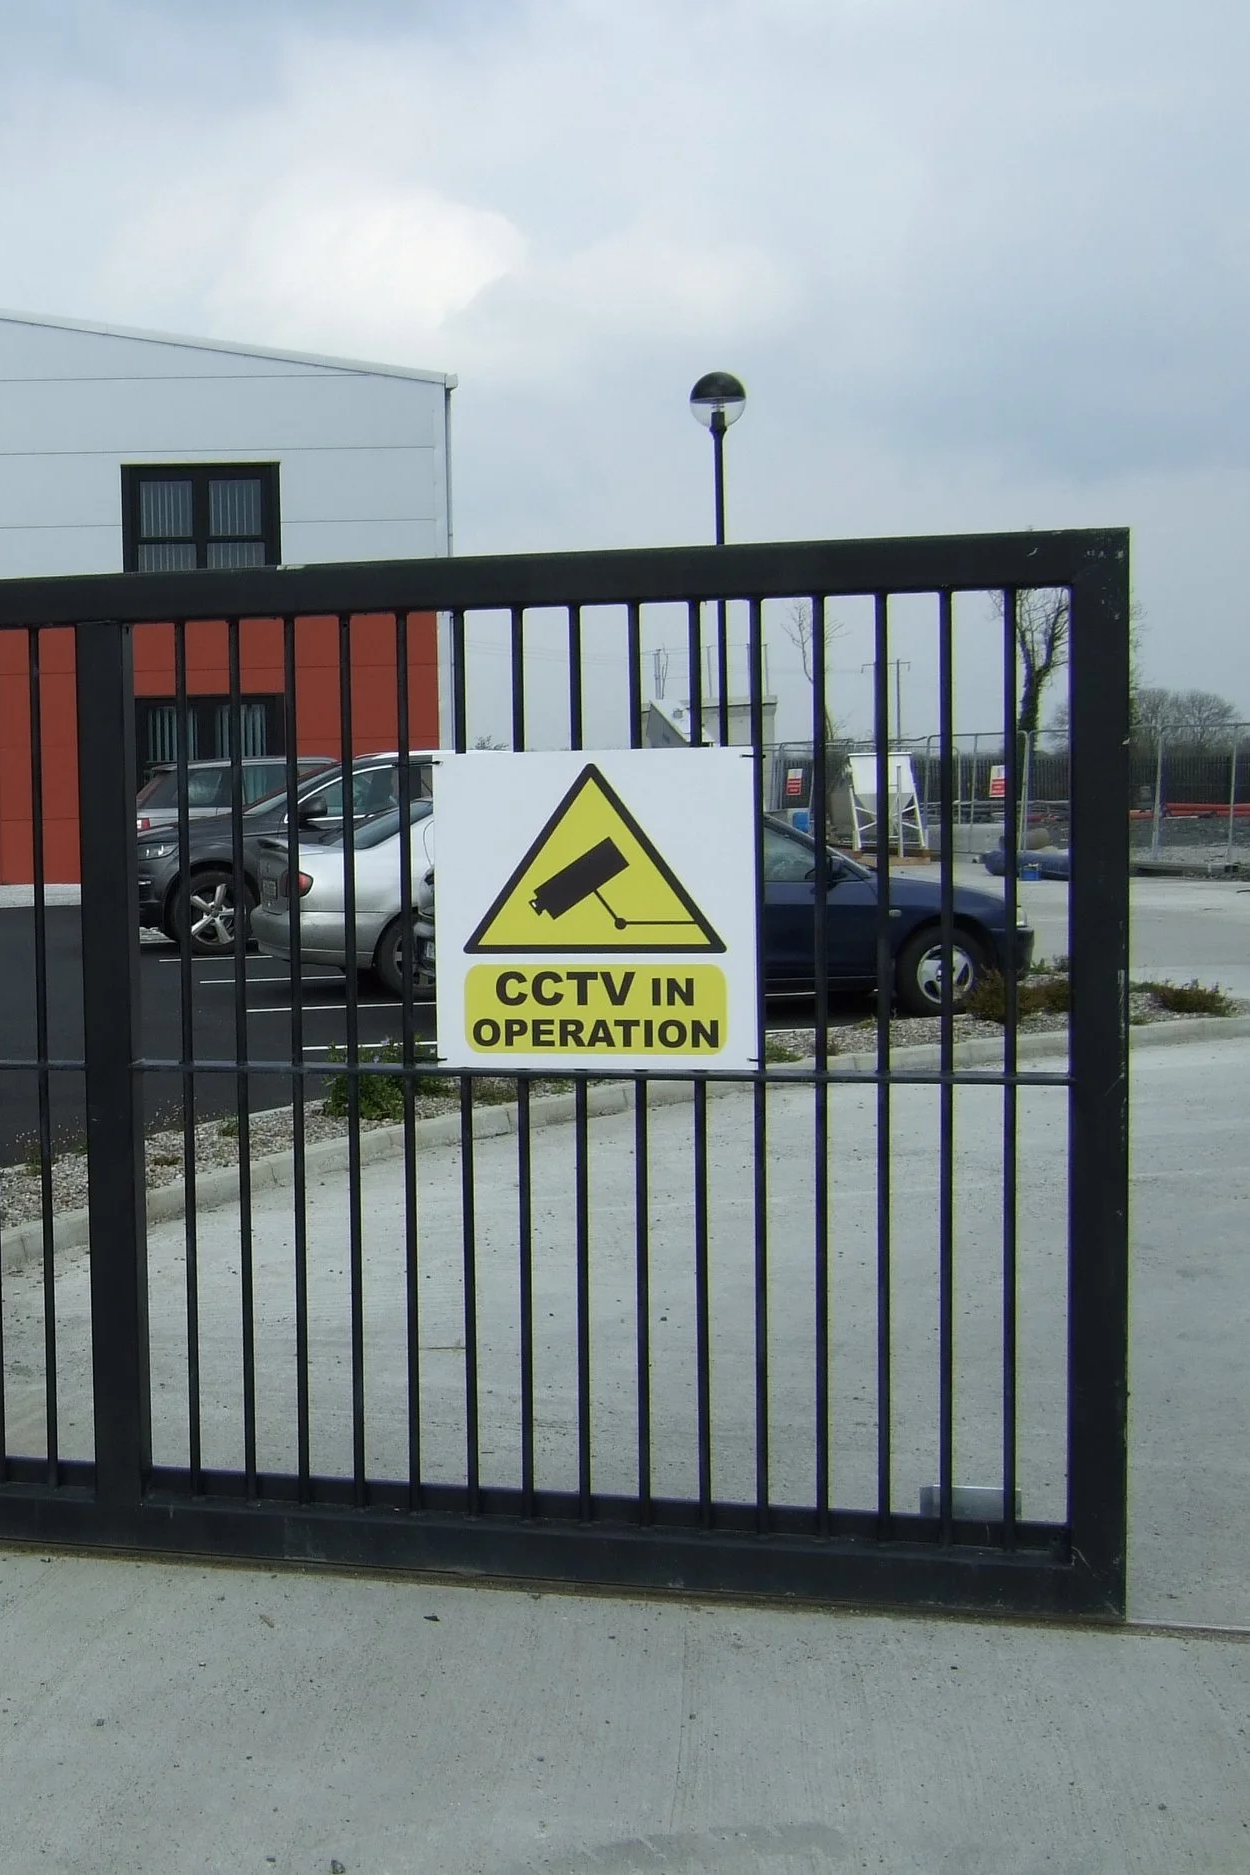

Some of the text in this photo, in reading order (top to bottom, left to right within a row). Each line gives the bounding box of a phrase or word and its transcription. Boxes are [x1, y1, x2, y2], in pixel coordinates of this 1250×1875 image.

[495, 971, 695, 1007] CCTV IN
[472, 1018, 720, 1049] OPERATION
